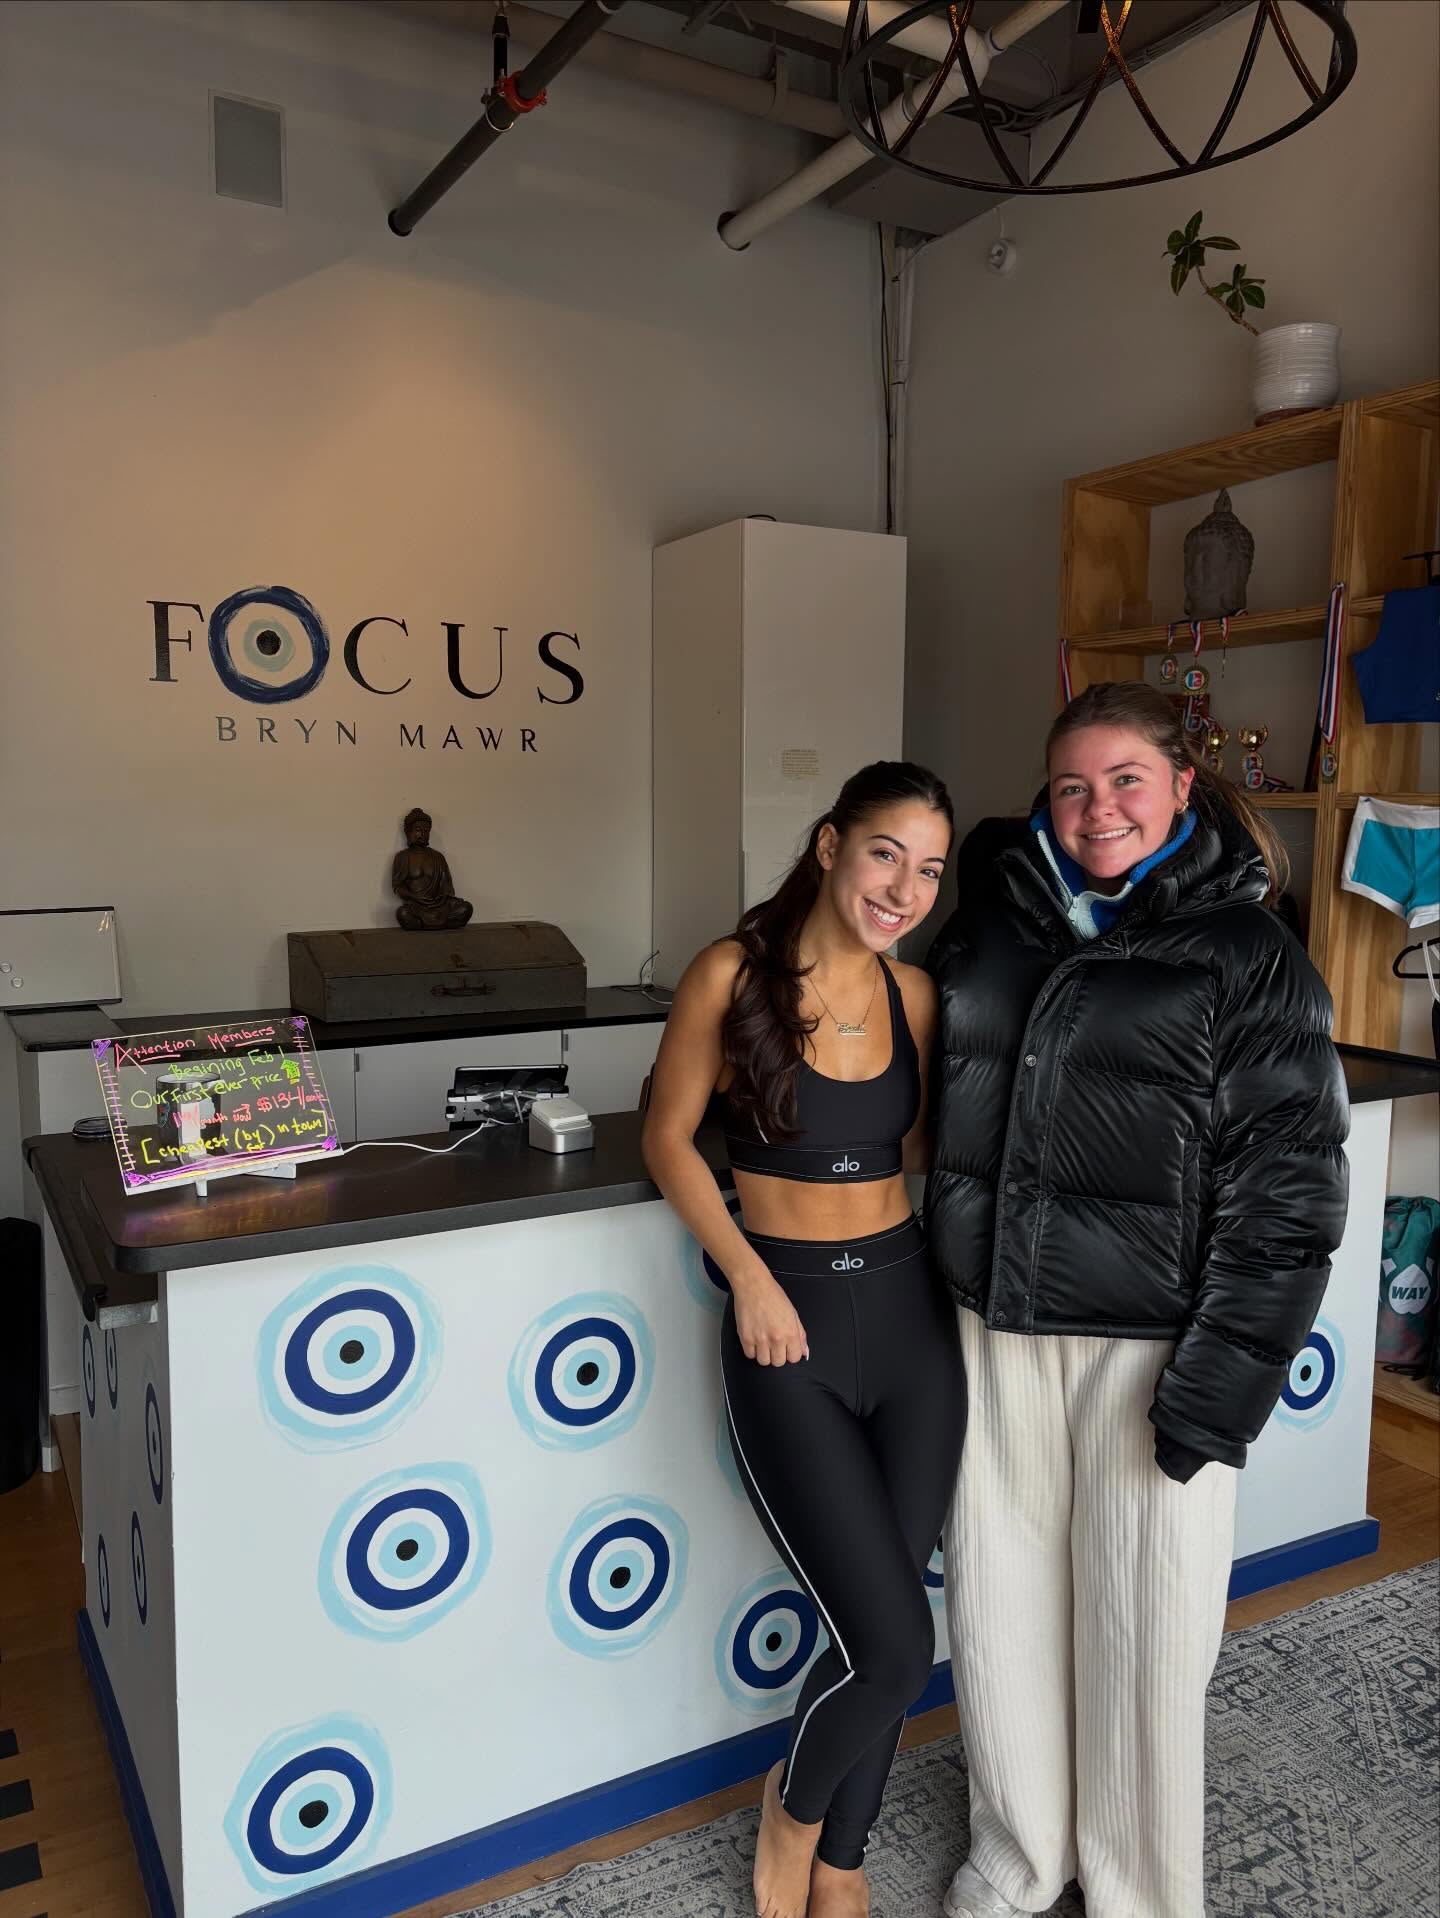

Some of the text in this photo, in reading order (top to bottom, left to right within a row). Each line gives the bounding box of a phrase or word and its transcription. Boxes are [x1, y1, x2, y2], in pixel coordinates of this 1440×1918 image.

[145, 585, 585, 704] FOCUS
[216, 716, 539, 753] BRYN MAWR
[115, 1026, 276, 1074] Attention Members
[247, 1049, 274, 1065] Feb
[131, 1089, 169, 1109] Our
[214, 1079, 248, 1095] ever
[832, 1154, 860, 1173] alo
[831, 1252, 864, 1271] alo
[1391, 1285, 1430, 1300] WAY
